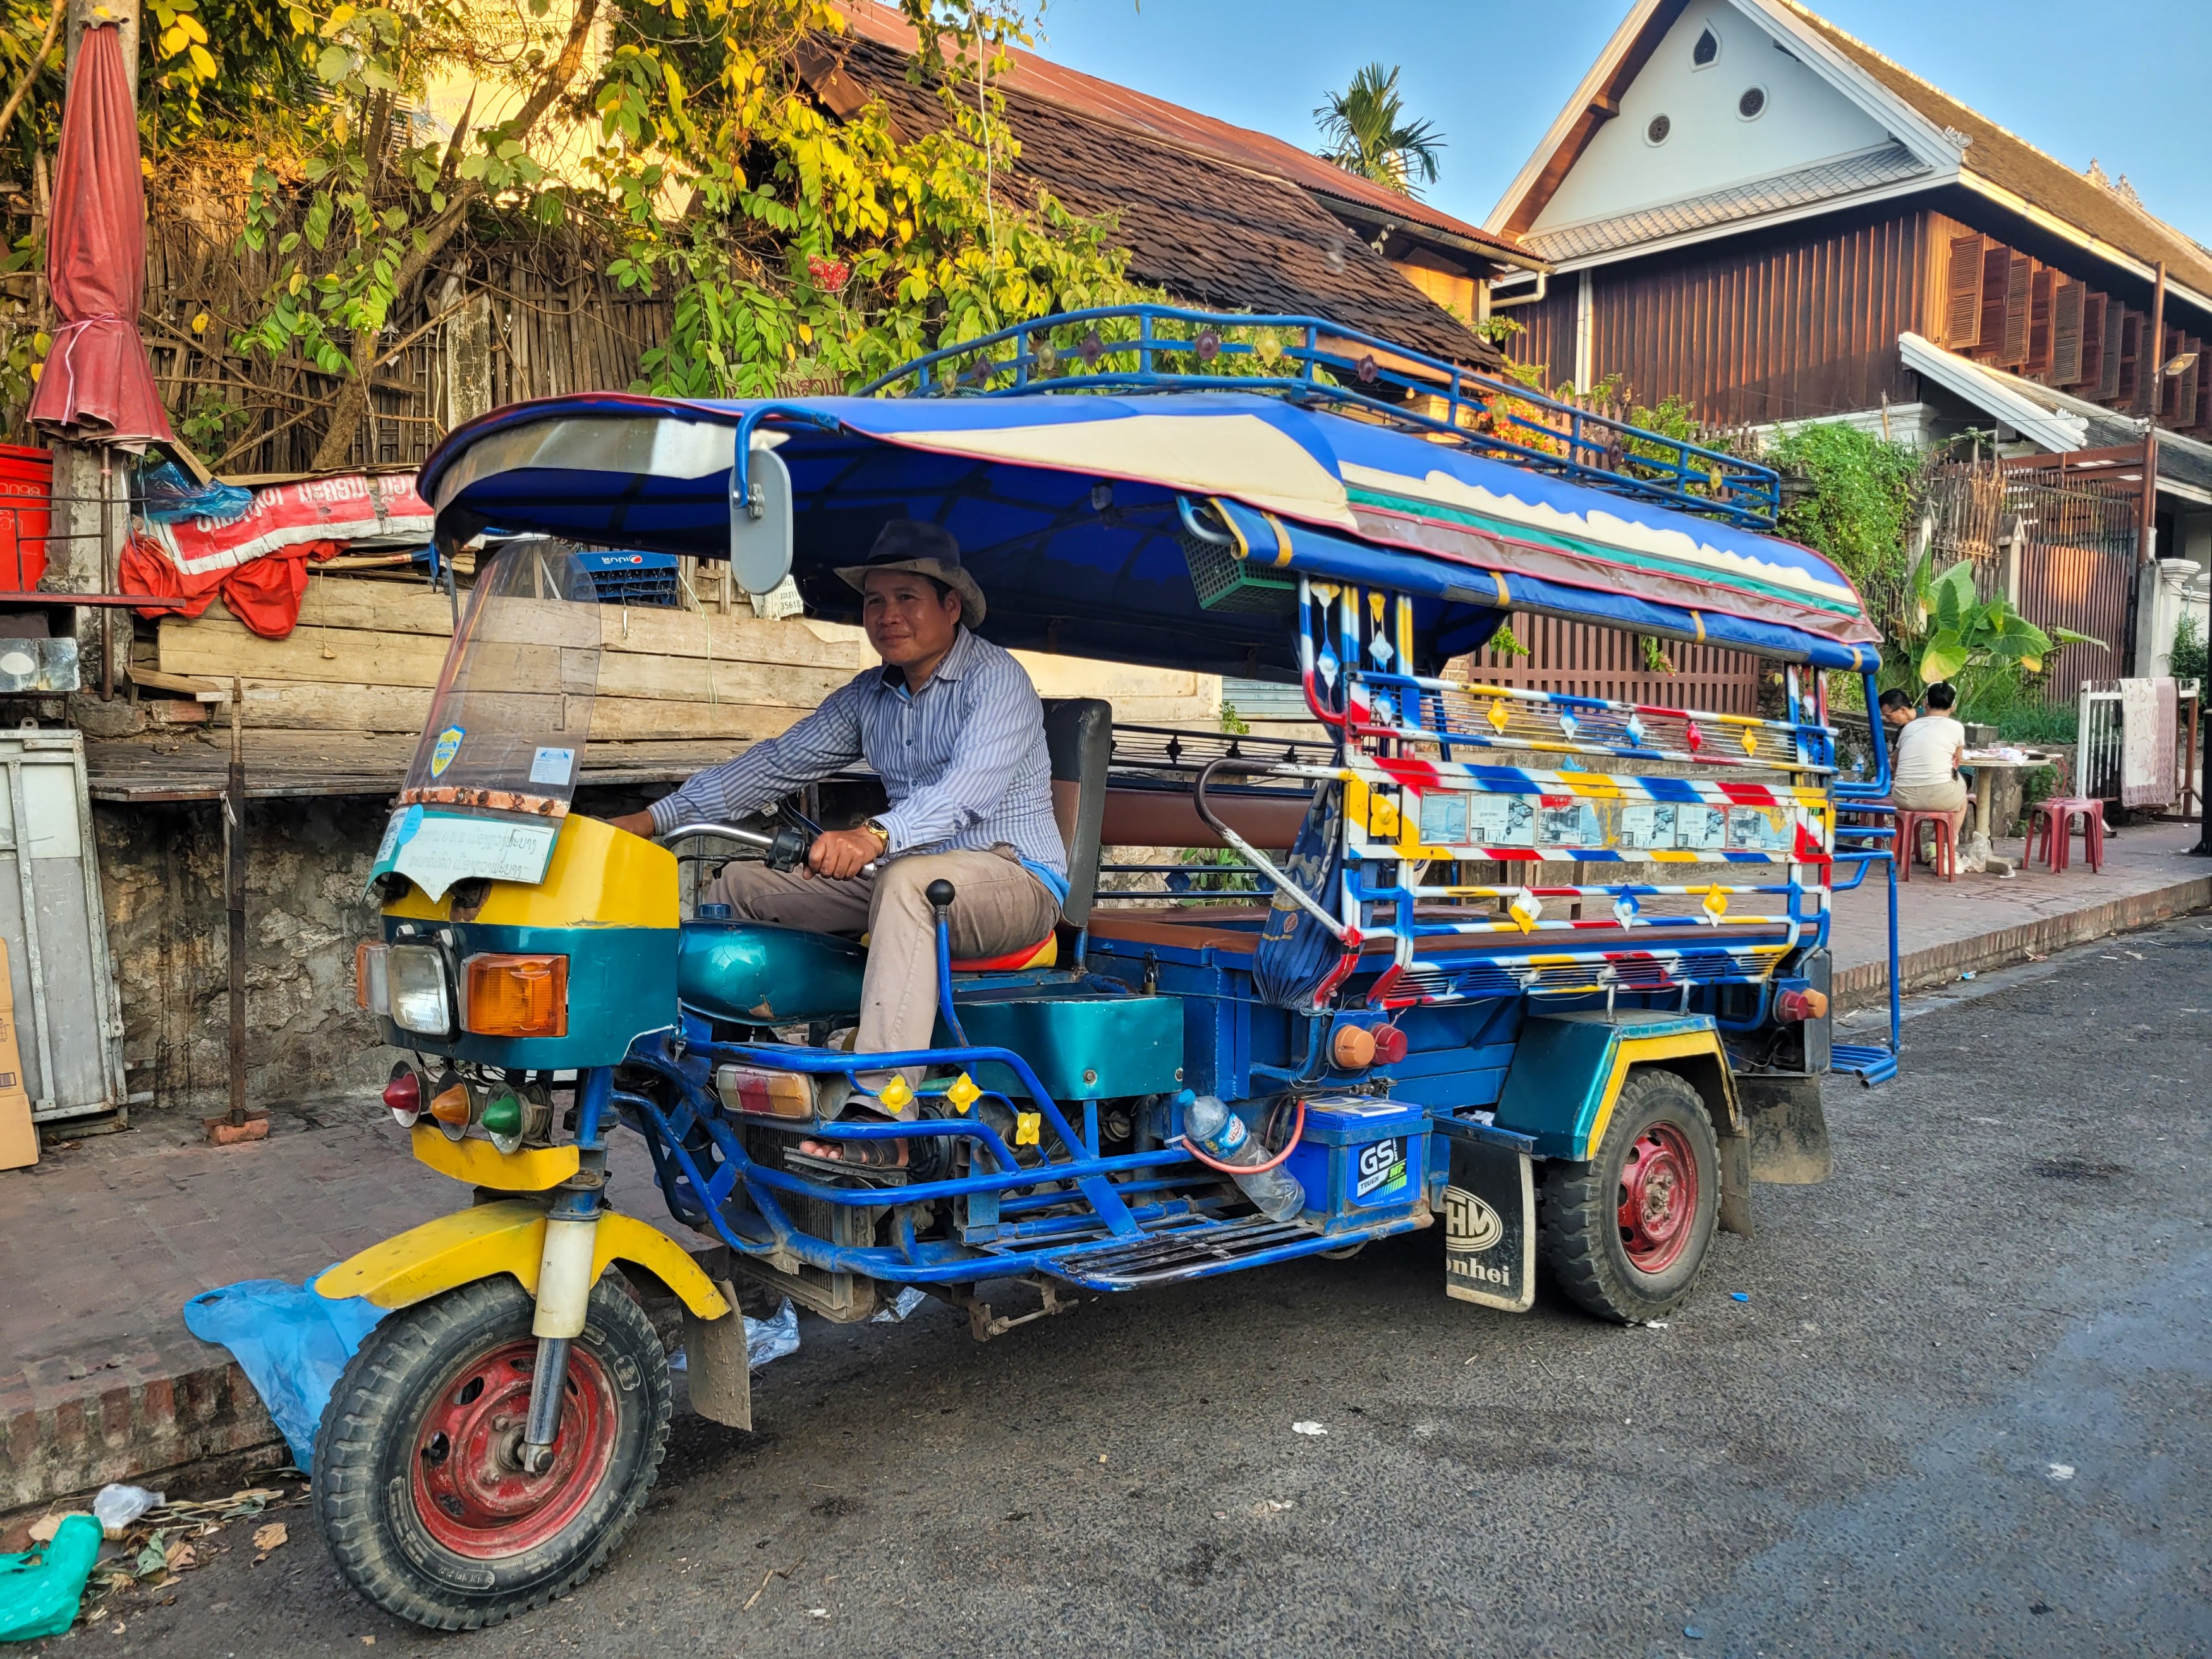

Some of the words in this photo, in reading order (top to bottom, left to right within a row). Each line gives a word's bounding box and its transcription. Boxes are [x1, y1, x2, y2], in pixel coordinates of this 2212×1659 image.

[1360, 1139, 1394, 1175] GS
[1360, 1176, 1380, 1189] TOUGH
[1389, 1162, 1406, 1178] MF
